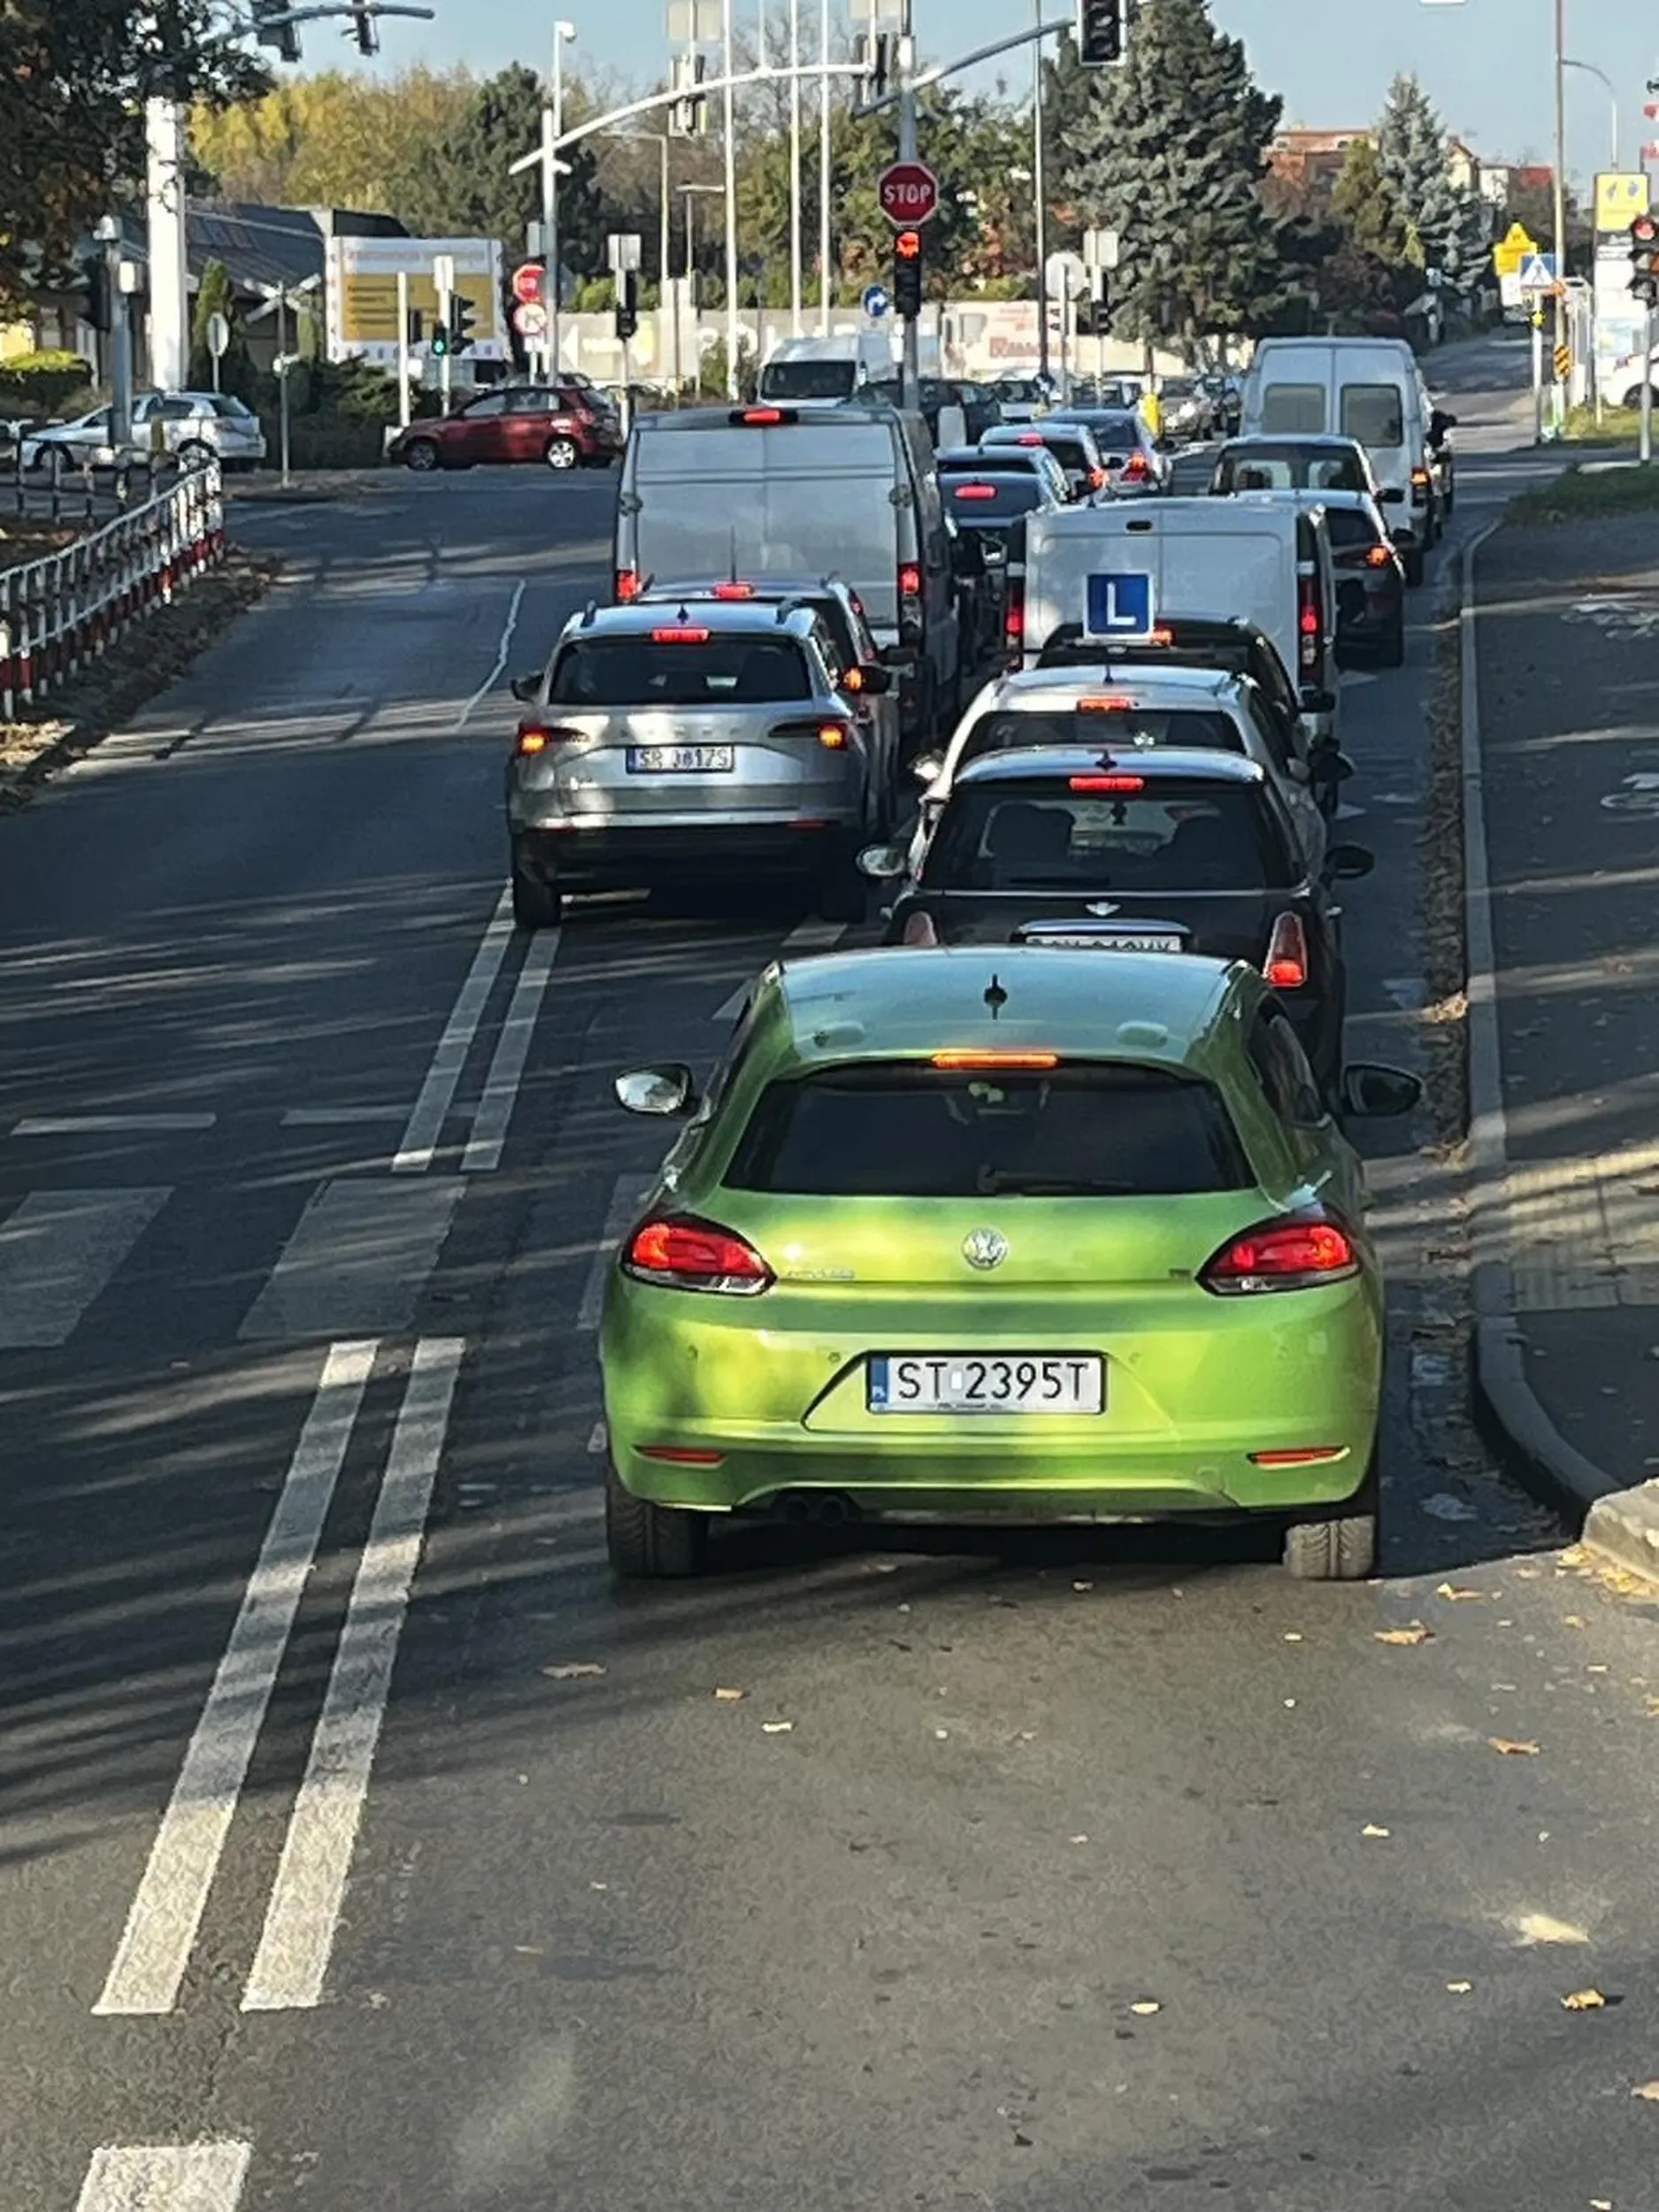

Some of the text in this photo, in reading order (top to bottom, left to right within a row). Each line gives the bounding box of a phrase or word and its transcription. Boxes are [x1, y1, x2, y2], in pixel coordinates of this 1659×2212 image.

[885, 184, 931, 204] STOP
[1107, 582, 1136, 626] L
[897, 1362, 948, 1400] ST
[965, 1362, 1089, 1400] 2395T
